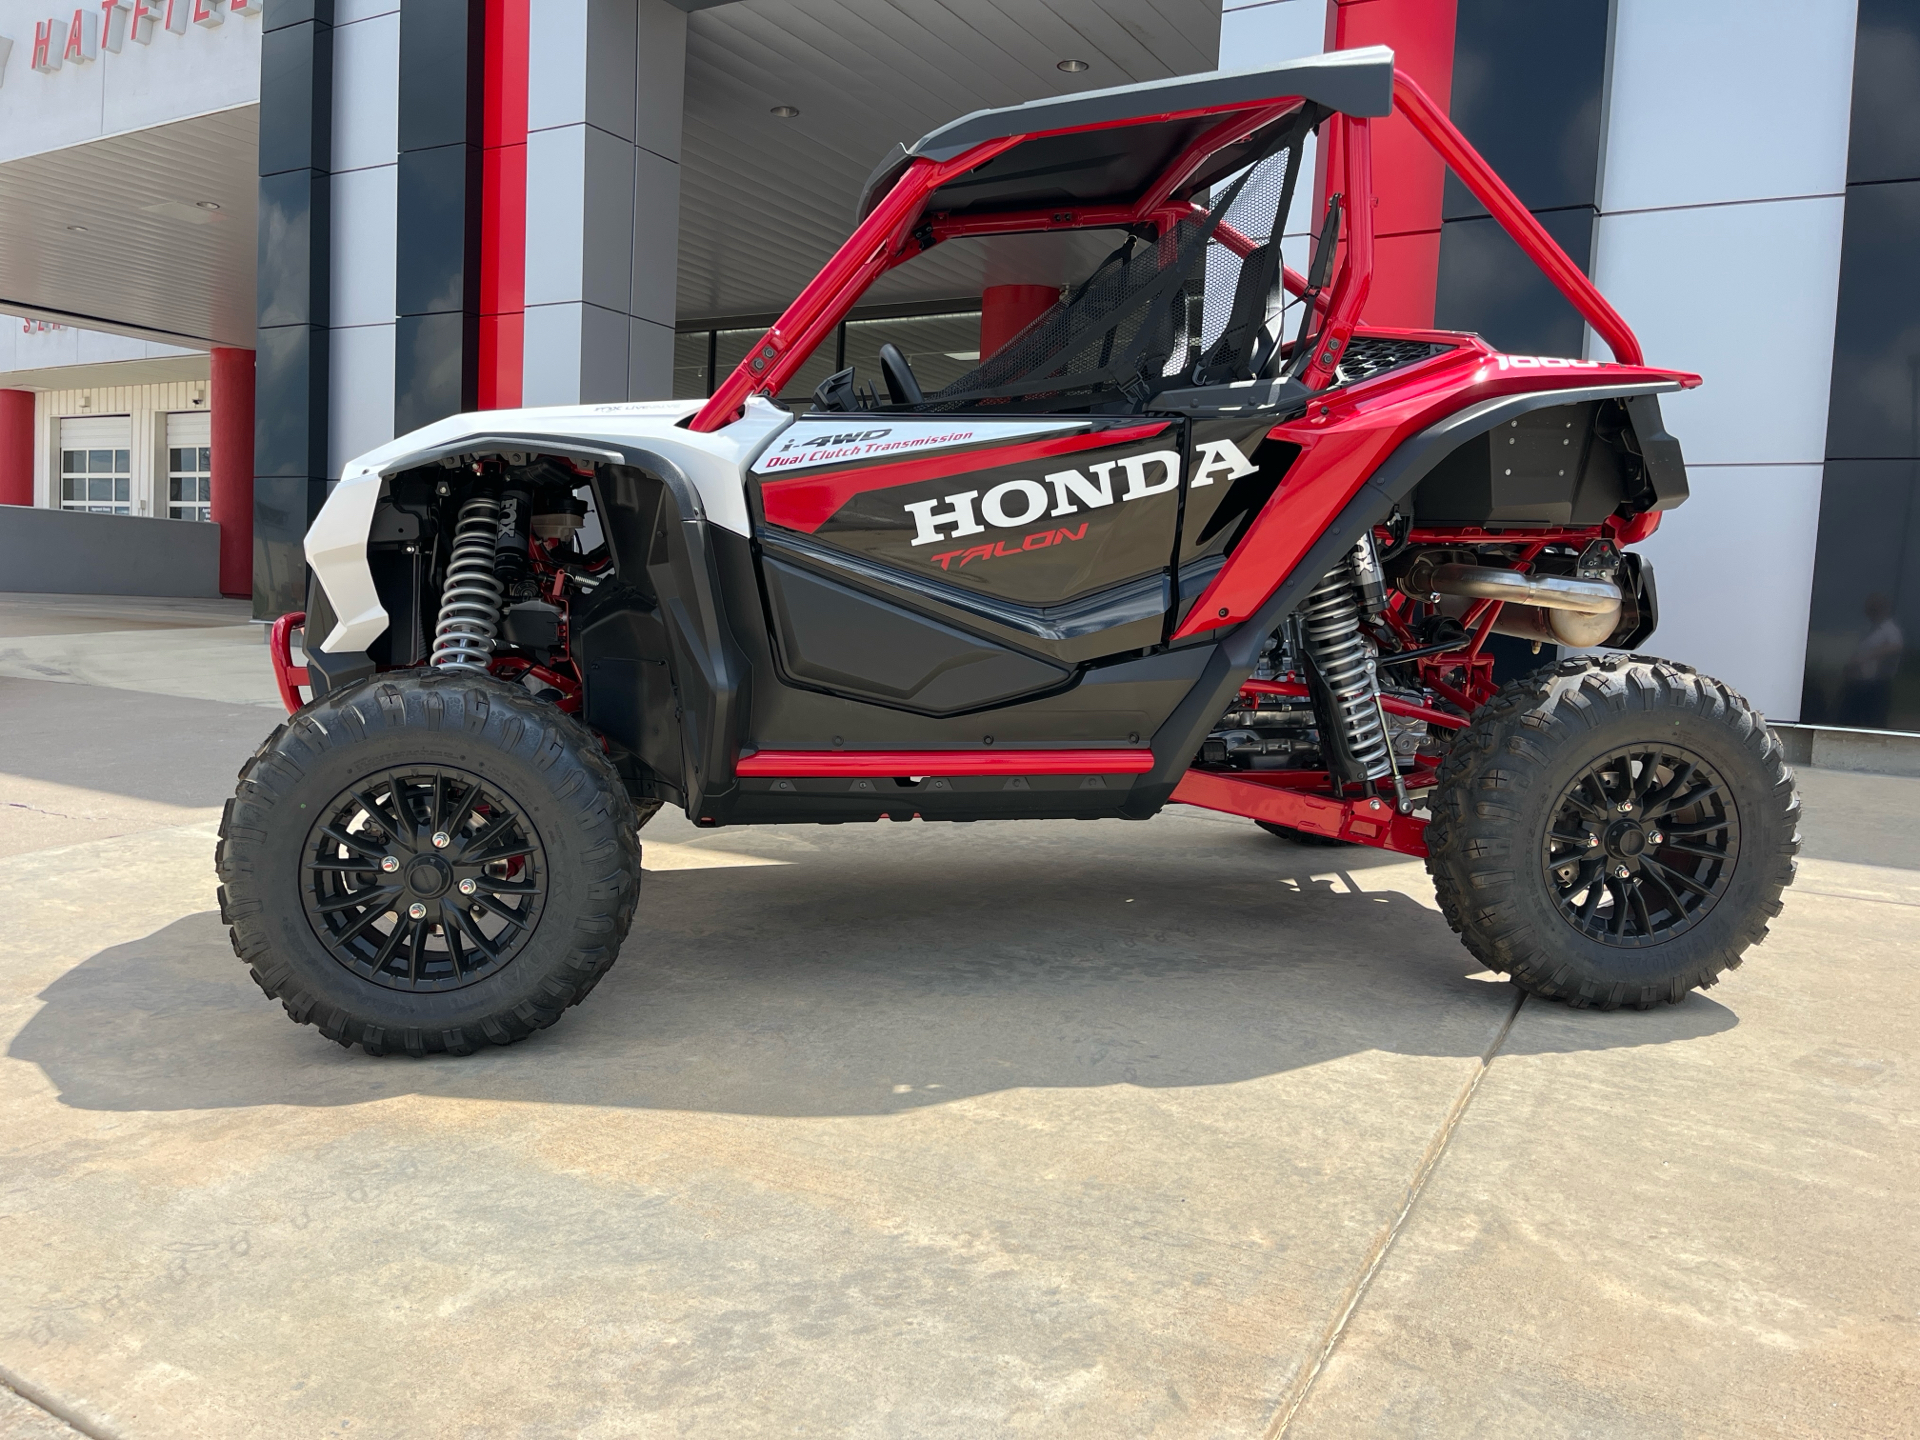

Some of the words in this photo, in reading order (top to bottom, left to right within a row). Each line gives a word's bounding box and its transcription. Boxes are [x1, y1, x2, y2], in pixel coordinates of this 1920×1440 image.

[31, 0, 248, 69] HATFI
[765, 450, 804, 468] Dual
[808, 445, 862, 462] Clutch
[864, 431, 974, 454] Transmission
[779, 428, 892, 452] i-4WD
[904, 438, 1260, 546] HONDA
[498, 498, 518, 540] FOX
[930, 522, 1089, 571] TALON
